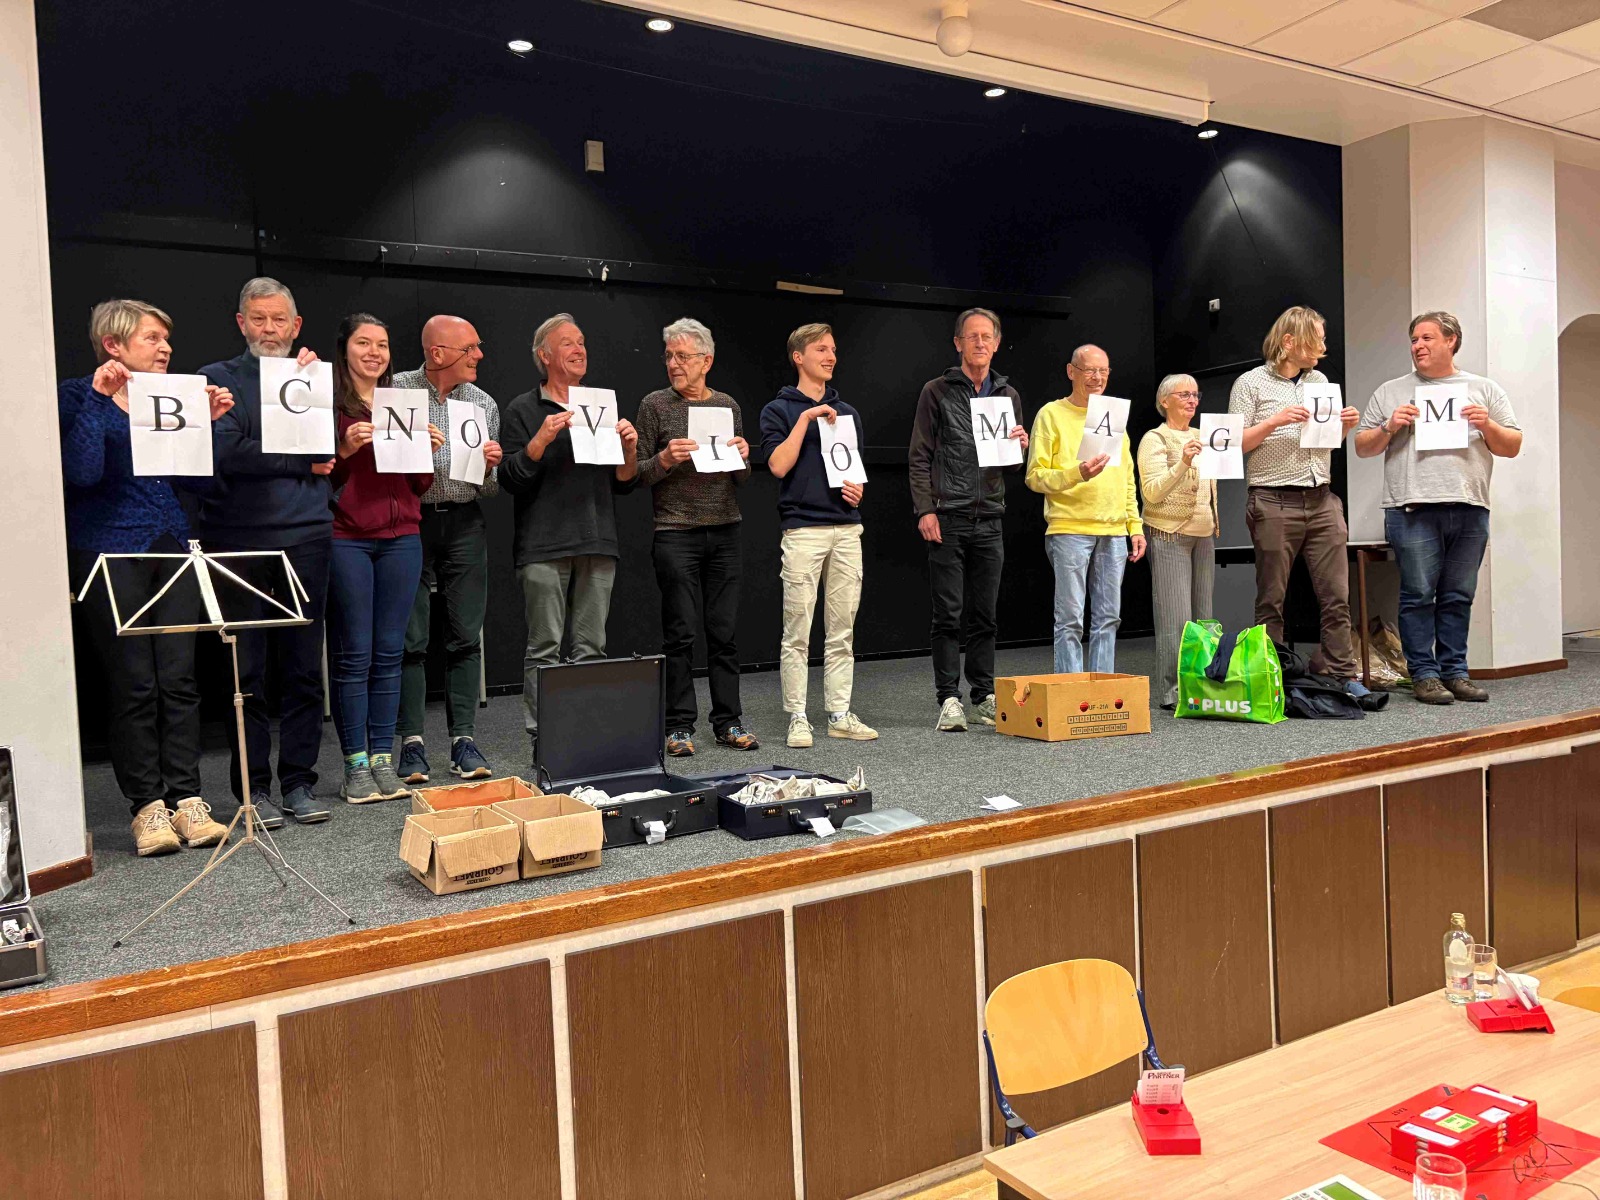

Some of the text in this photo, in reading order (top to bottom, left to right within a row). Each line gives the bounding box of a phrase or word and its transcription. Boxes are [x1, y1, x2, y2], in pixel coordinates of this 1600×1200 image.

[279, 378, 311, 414] C
[1311, 396, 1334, 424] U
[149, 395, 187, 432] B
[383, 406, 416, 441] N
[578, 404, 607, 436] V
[1093, 411, 1114, 437] A
[1423, 397, 1457, 424] M
[460, 419, 482, 449] O
[978, 411, 1009, 441] M
[1209, 427, 1231, 452] G
[708, 435, 725, 461] I
[829, 442, 852, 471] O
[1202, 698, 1252, 714] PLUS
[453, 866, 504, 882] GOURMET
